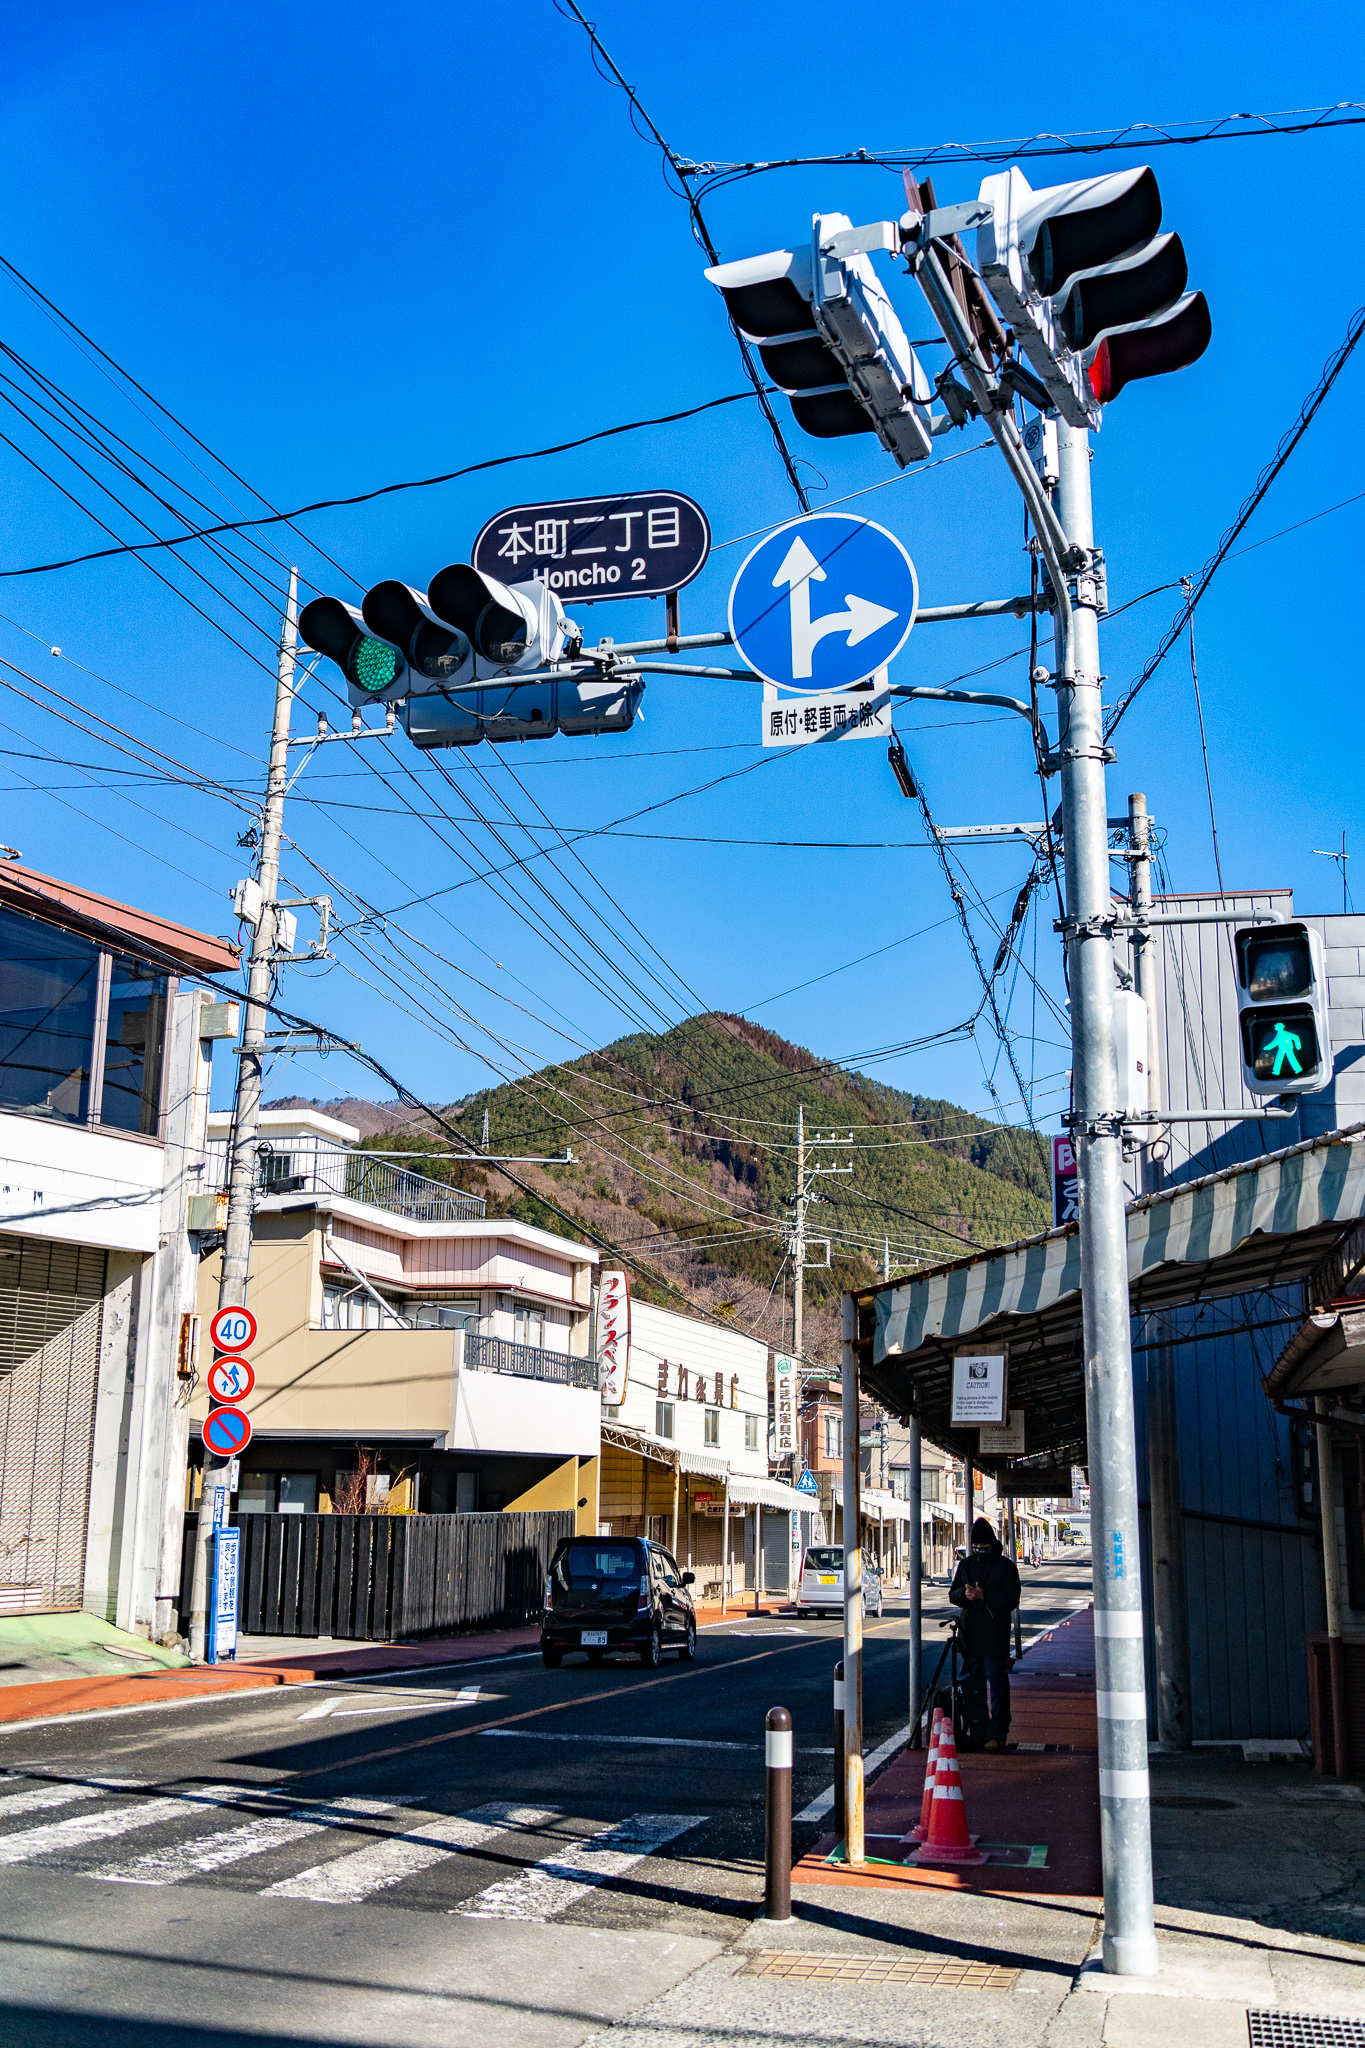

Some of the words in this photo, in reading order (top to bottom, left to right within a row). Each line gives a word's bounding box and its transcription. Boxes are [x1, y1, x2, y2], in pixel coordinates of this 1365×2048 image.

[497, 506, 680, 565] 本町二丁目
[533, 562, 621, 589] Honcho
[631, 557, 646, 581] 2
[220, 1318, 247, 1340] 40
[600, 1277, 620, 1398] フランスベッド
[779, 1376, 792, 1449] ときわ家具店
